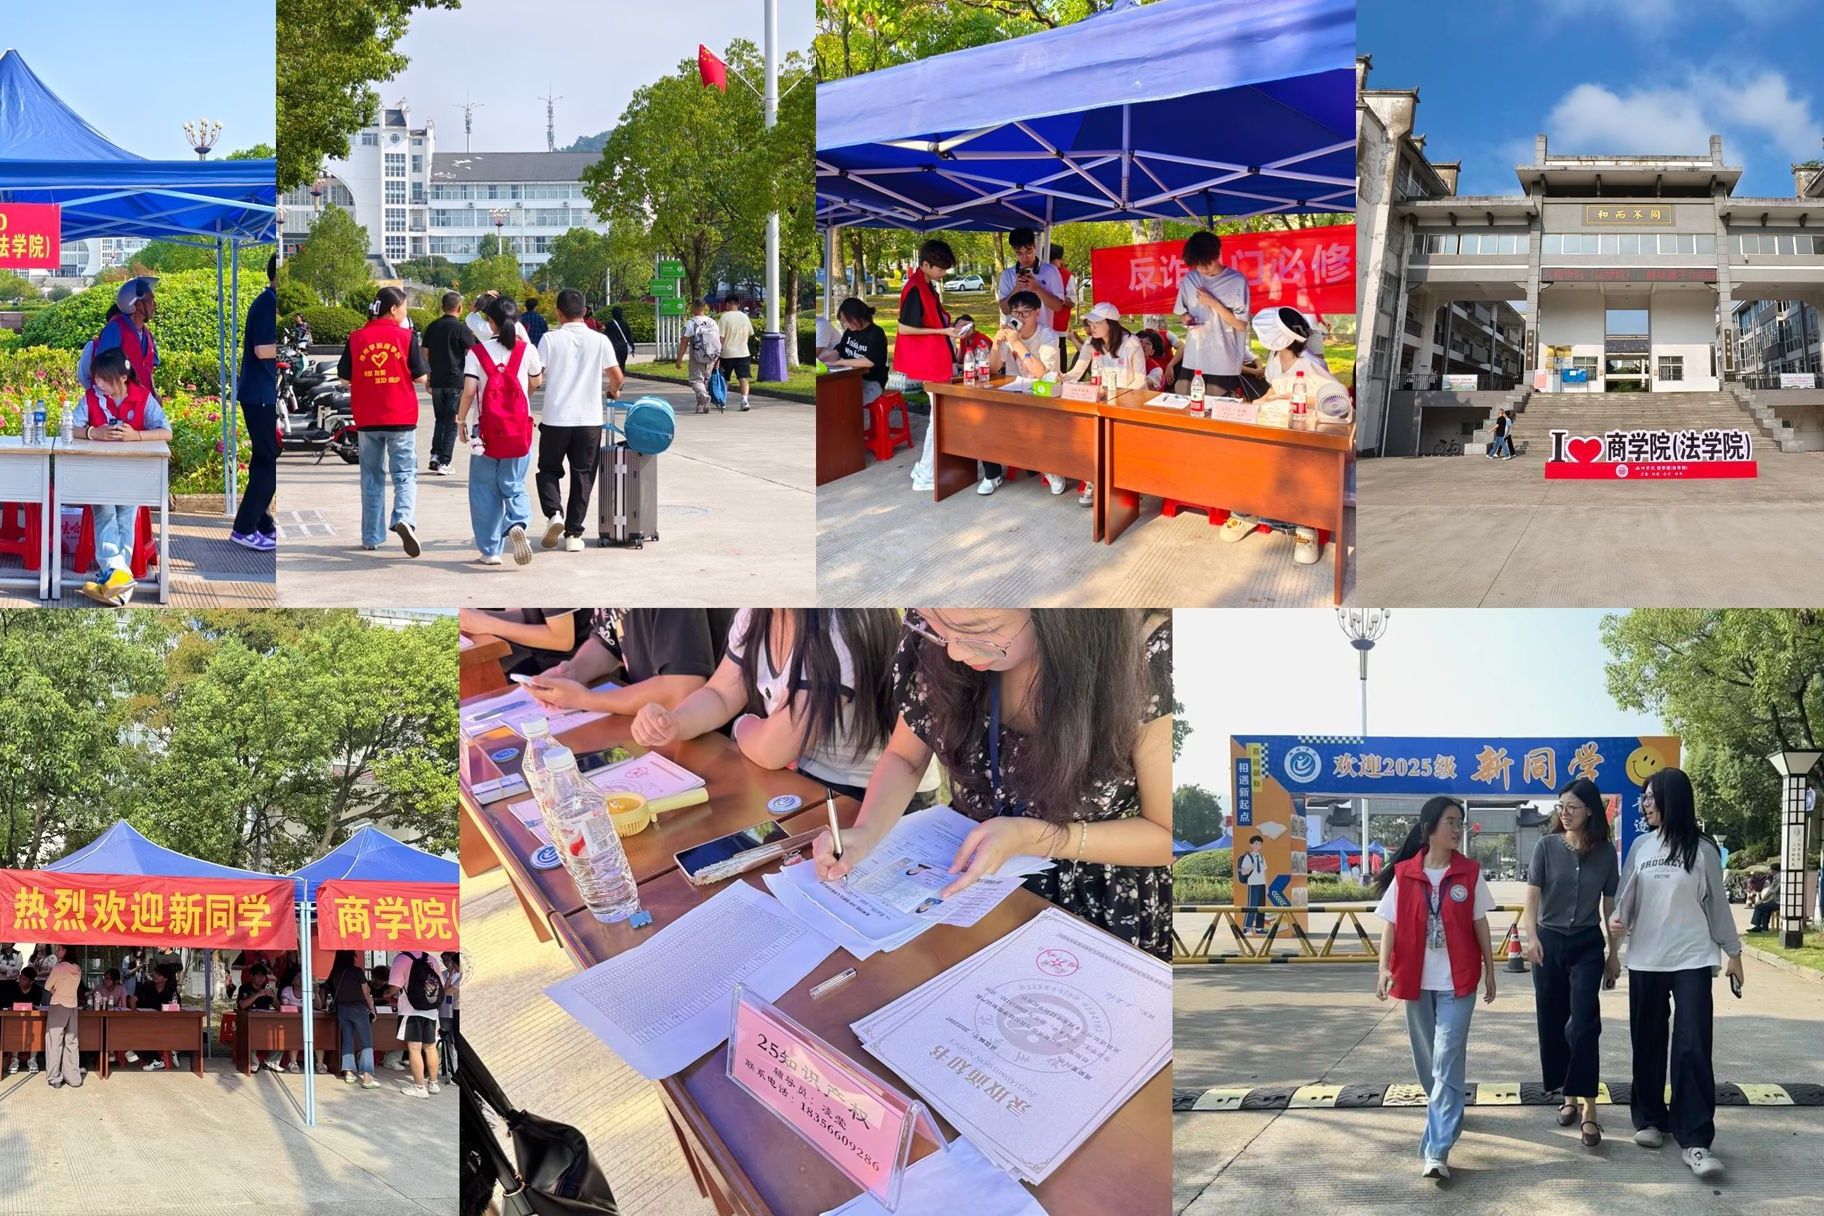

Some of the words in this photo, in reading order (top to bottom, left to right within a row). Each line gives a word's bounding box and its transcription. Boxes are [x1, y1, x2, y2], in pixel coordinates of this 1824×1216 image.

[1597, 209, 1661, 220] 和而不同
[1129, 242, 1352, 292] 反诈门必修
[1607, 432, 1751, 461] 商学院(法学院)
[1332, 752, 1458, 780] 欢迎2025级
[1471, 741, 1605, 791] 新同学
[1239, 762, 1250, 822] 相遇新起点
[14, 886, 273, 937] 热烈欢迎新同学
[757, 1033, 870, 1130] 25知识产权
[929, 1044, 1033, 1118] 录取通知书
